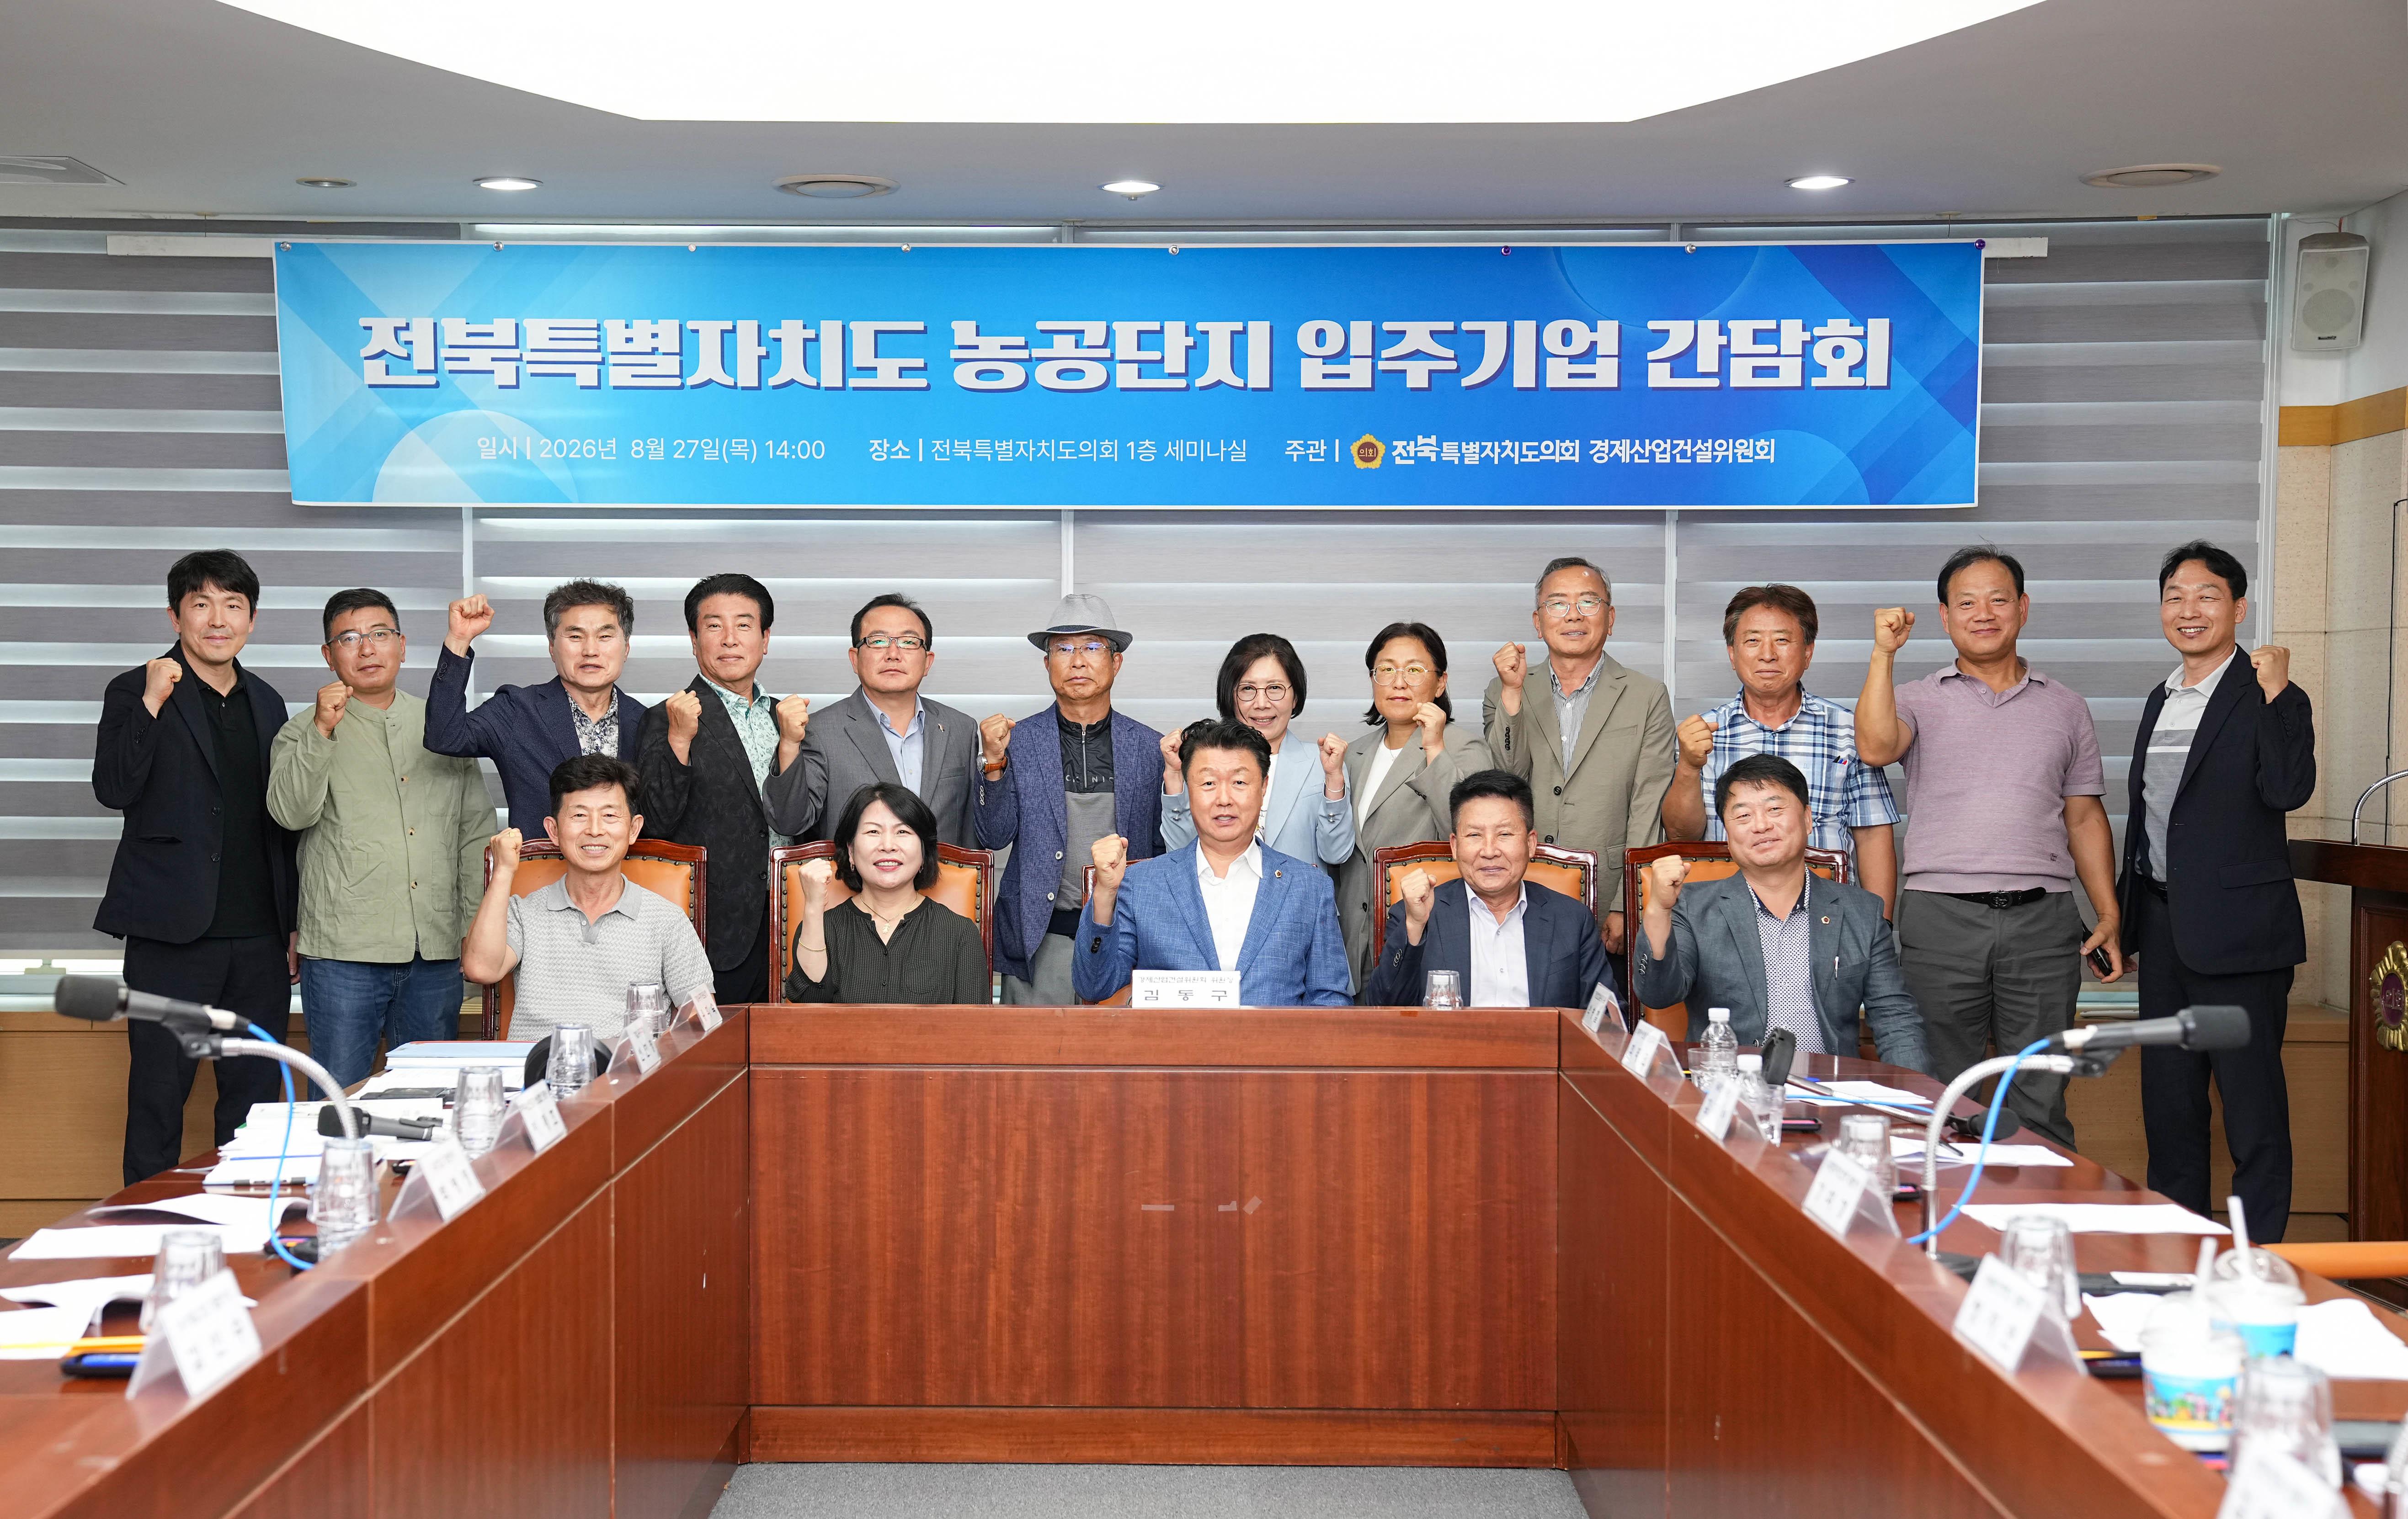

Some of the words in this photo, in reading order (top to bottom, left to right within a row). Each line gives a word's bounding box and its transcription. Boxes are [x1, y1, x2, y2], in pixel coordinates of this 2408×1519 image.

[357, 316, 930, 390] 전북특별자치도
[950, 320, 1273, 391] 농공단지
[1297, 319, 1621, 390] 입주기업
[1647, 318, 1892, 389] 간담회
[477, 437, 518, 460] 일시
[540, 438, 617, 461] 2026년
[631, 438, 665, 461] 8월
[673, 438, 758, 464] 27일(목)
[765, 440, 826, 460] 14:00
[869, 439, 912, 462] 장소
[931, 439, 1119, 462] 전북특별자치도의회
[1126, 440, 1158, 462] 1층
[1164, 440, 1247, 462] 세미나실
[1285, 439, 1328, 462] 주관
[1358, 447, 1376, 457] 의회
[1391, 435, 1581, 465] 전북특별자치도의회
[1589, 438, 1776, 464] 경제산업건설위원회
